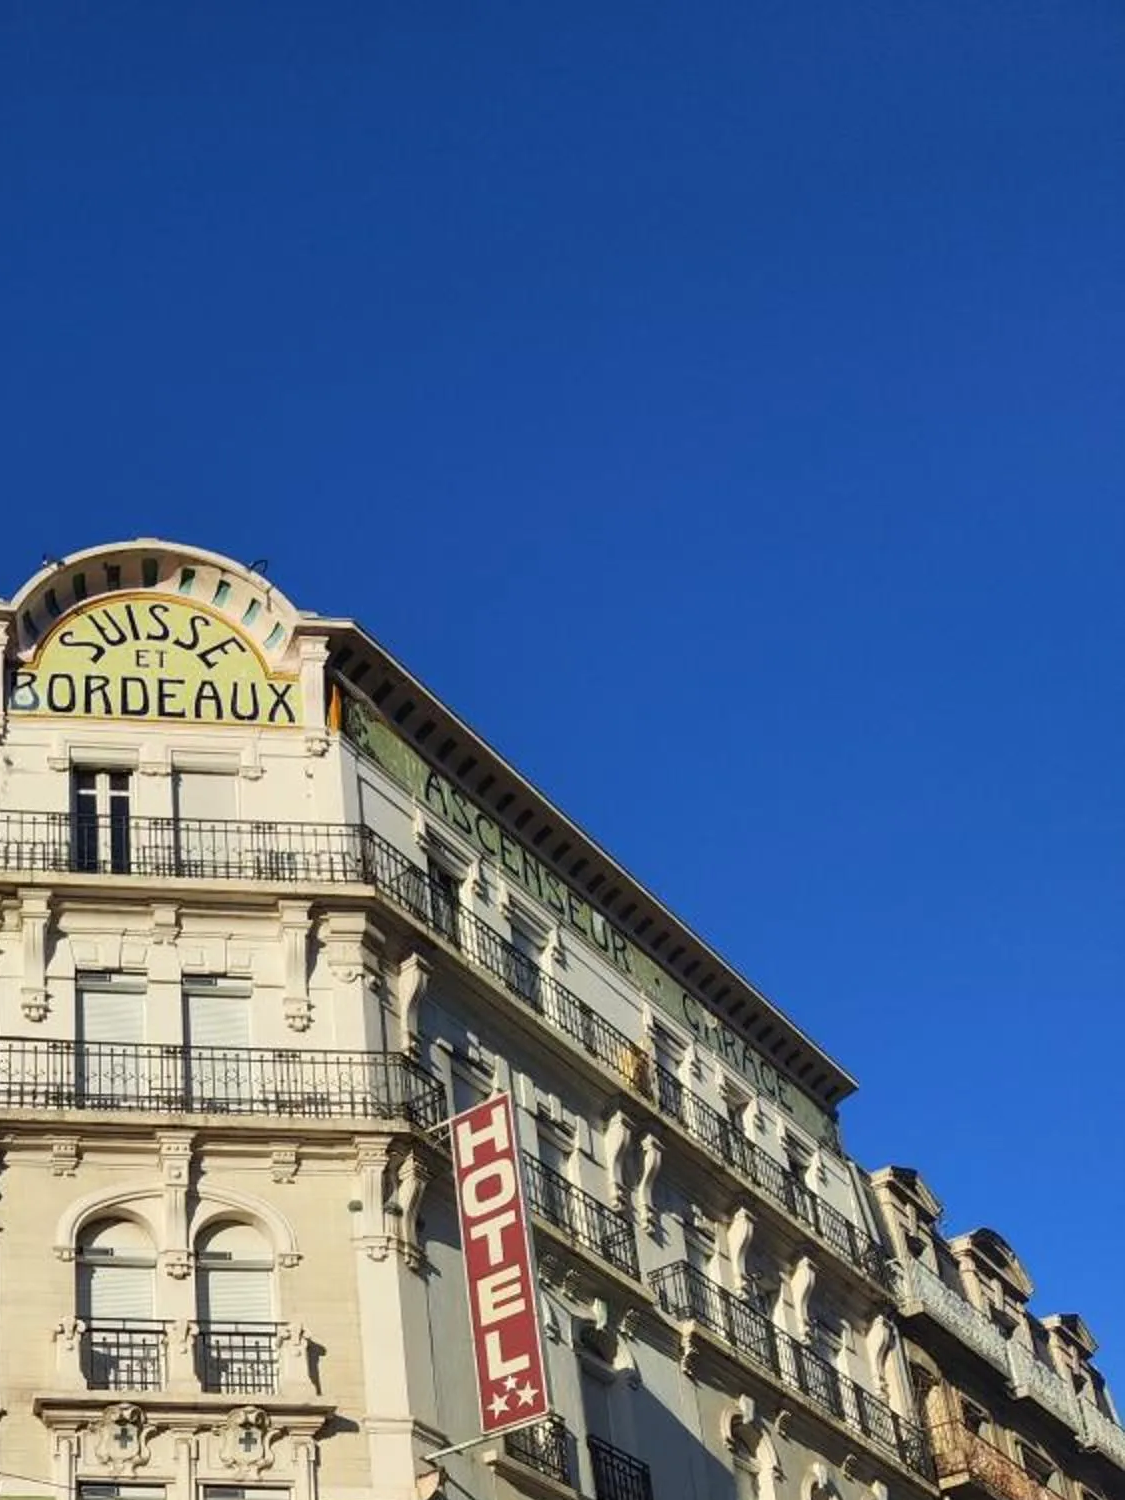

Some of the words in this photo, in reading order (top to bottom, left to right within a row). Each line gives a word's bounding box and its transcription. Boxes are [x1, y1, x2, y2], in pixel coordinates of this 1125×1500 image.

[59, 603, 246, 668] SUISSE
[135, 650, 167, 668] ET
[10, 671, 296, 723] BORDEAUX
[424, 766, 633, 974] ASCENSEUR
[457, 1103, 530, 1381] HOTEL
